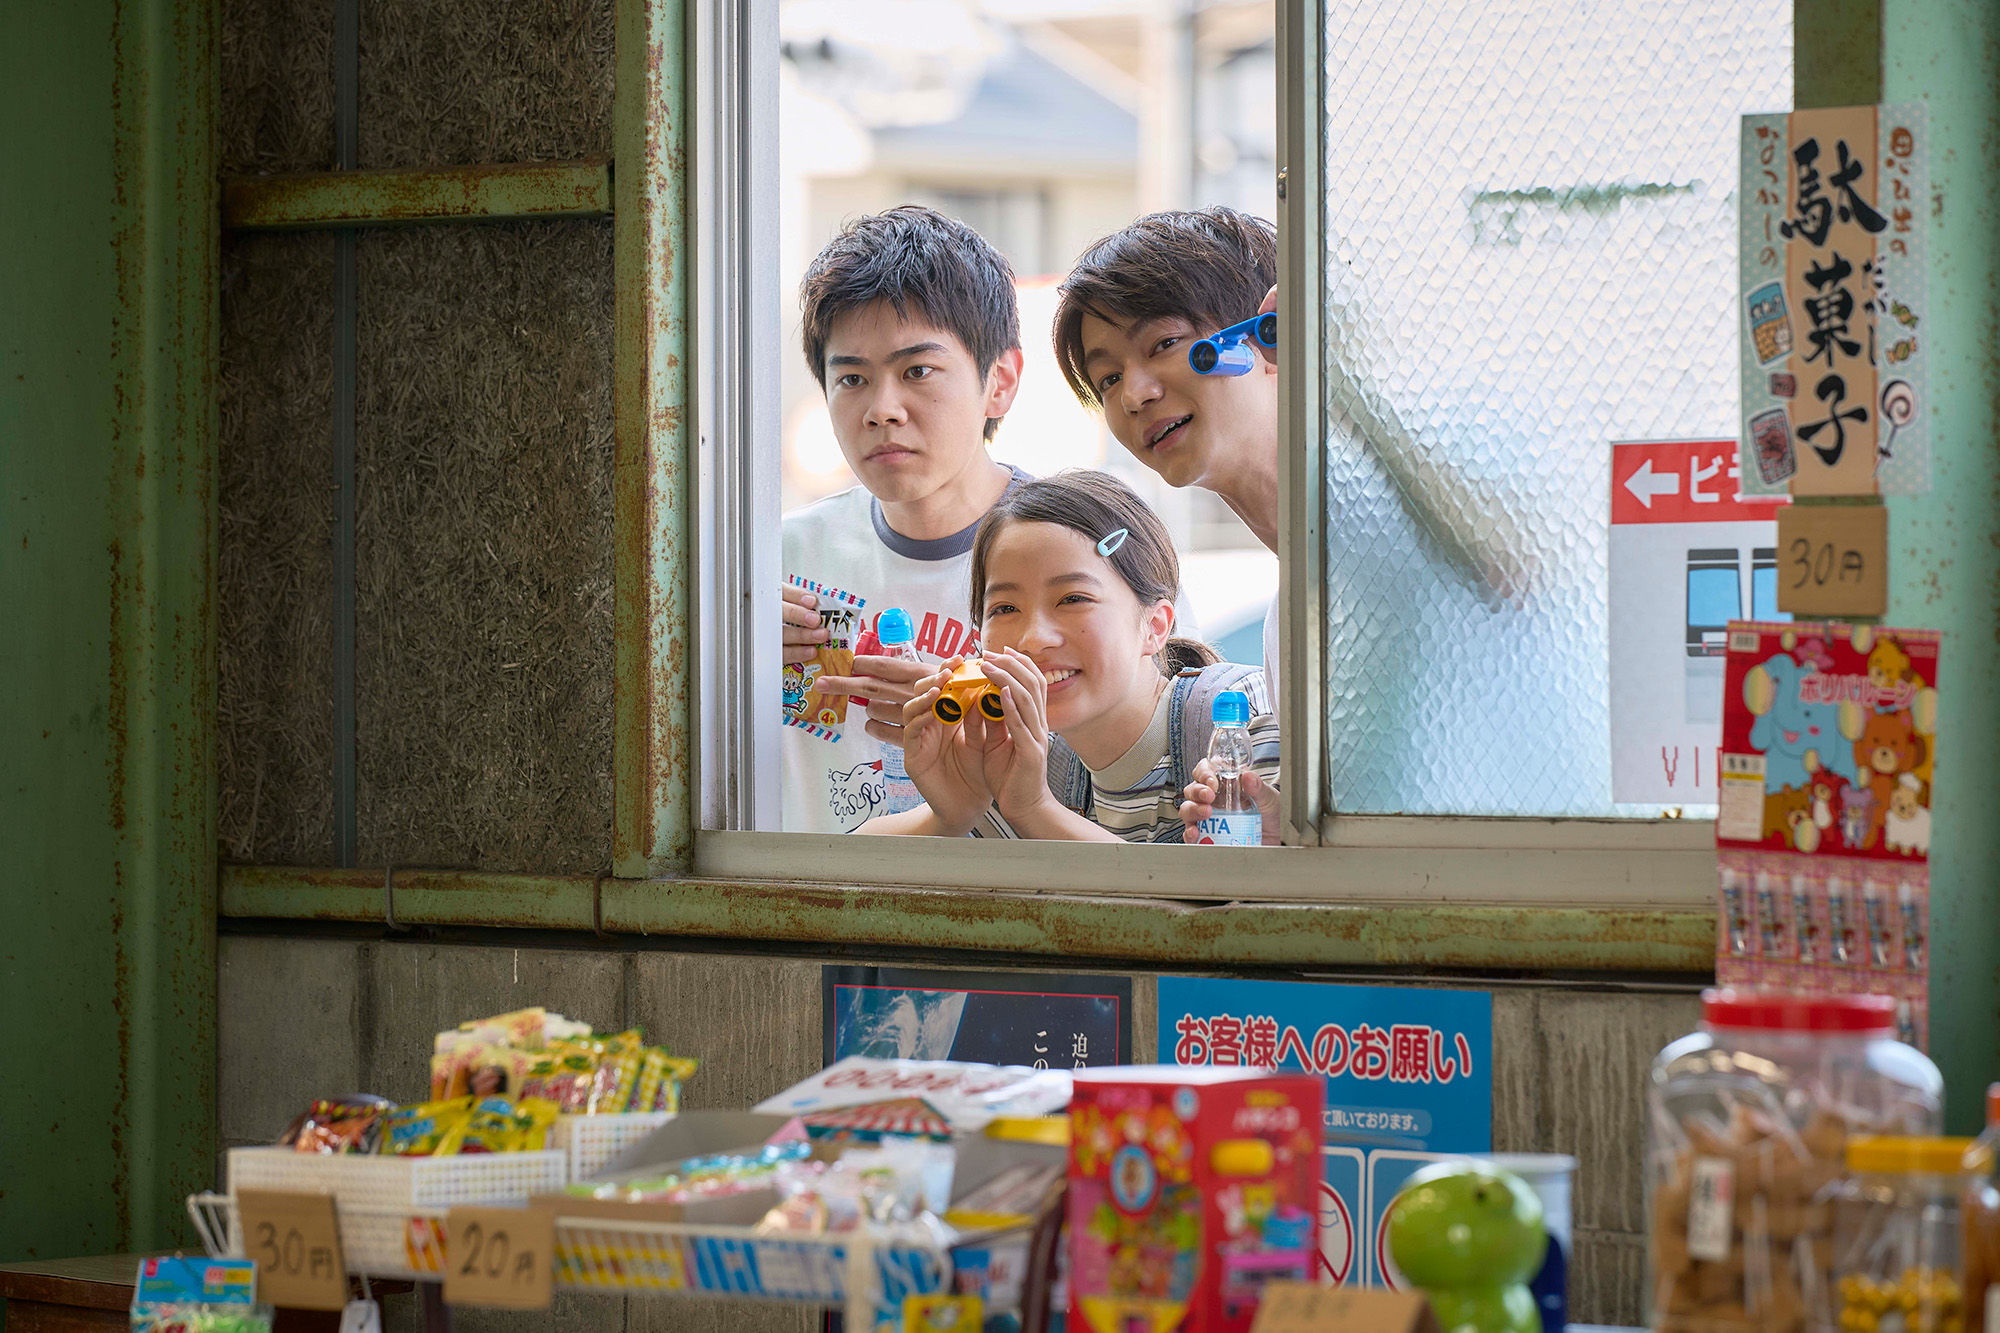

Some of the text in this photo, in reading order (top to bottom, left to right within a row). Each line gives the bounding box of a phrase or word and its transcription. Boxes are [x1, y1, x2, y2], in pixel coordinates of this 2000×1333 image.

[1780, 137, 1888, 467] 駄菓子
[1789, 537, 1865, 589] 30円
[1198, 817, 1231, 834] ATA
[1175, 1012, 1472, 1084] お客様へのお願い
[255, 1221, 333, 1282] 30円
[460, 1221, 536, 1286] 20円
